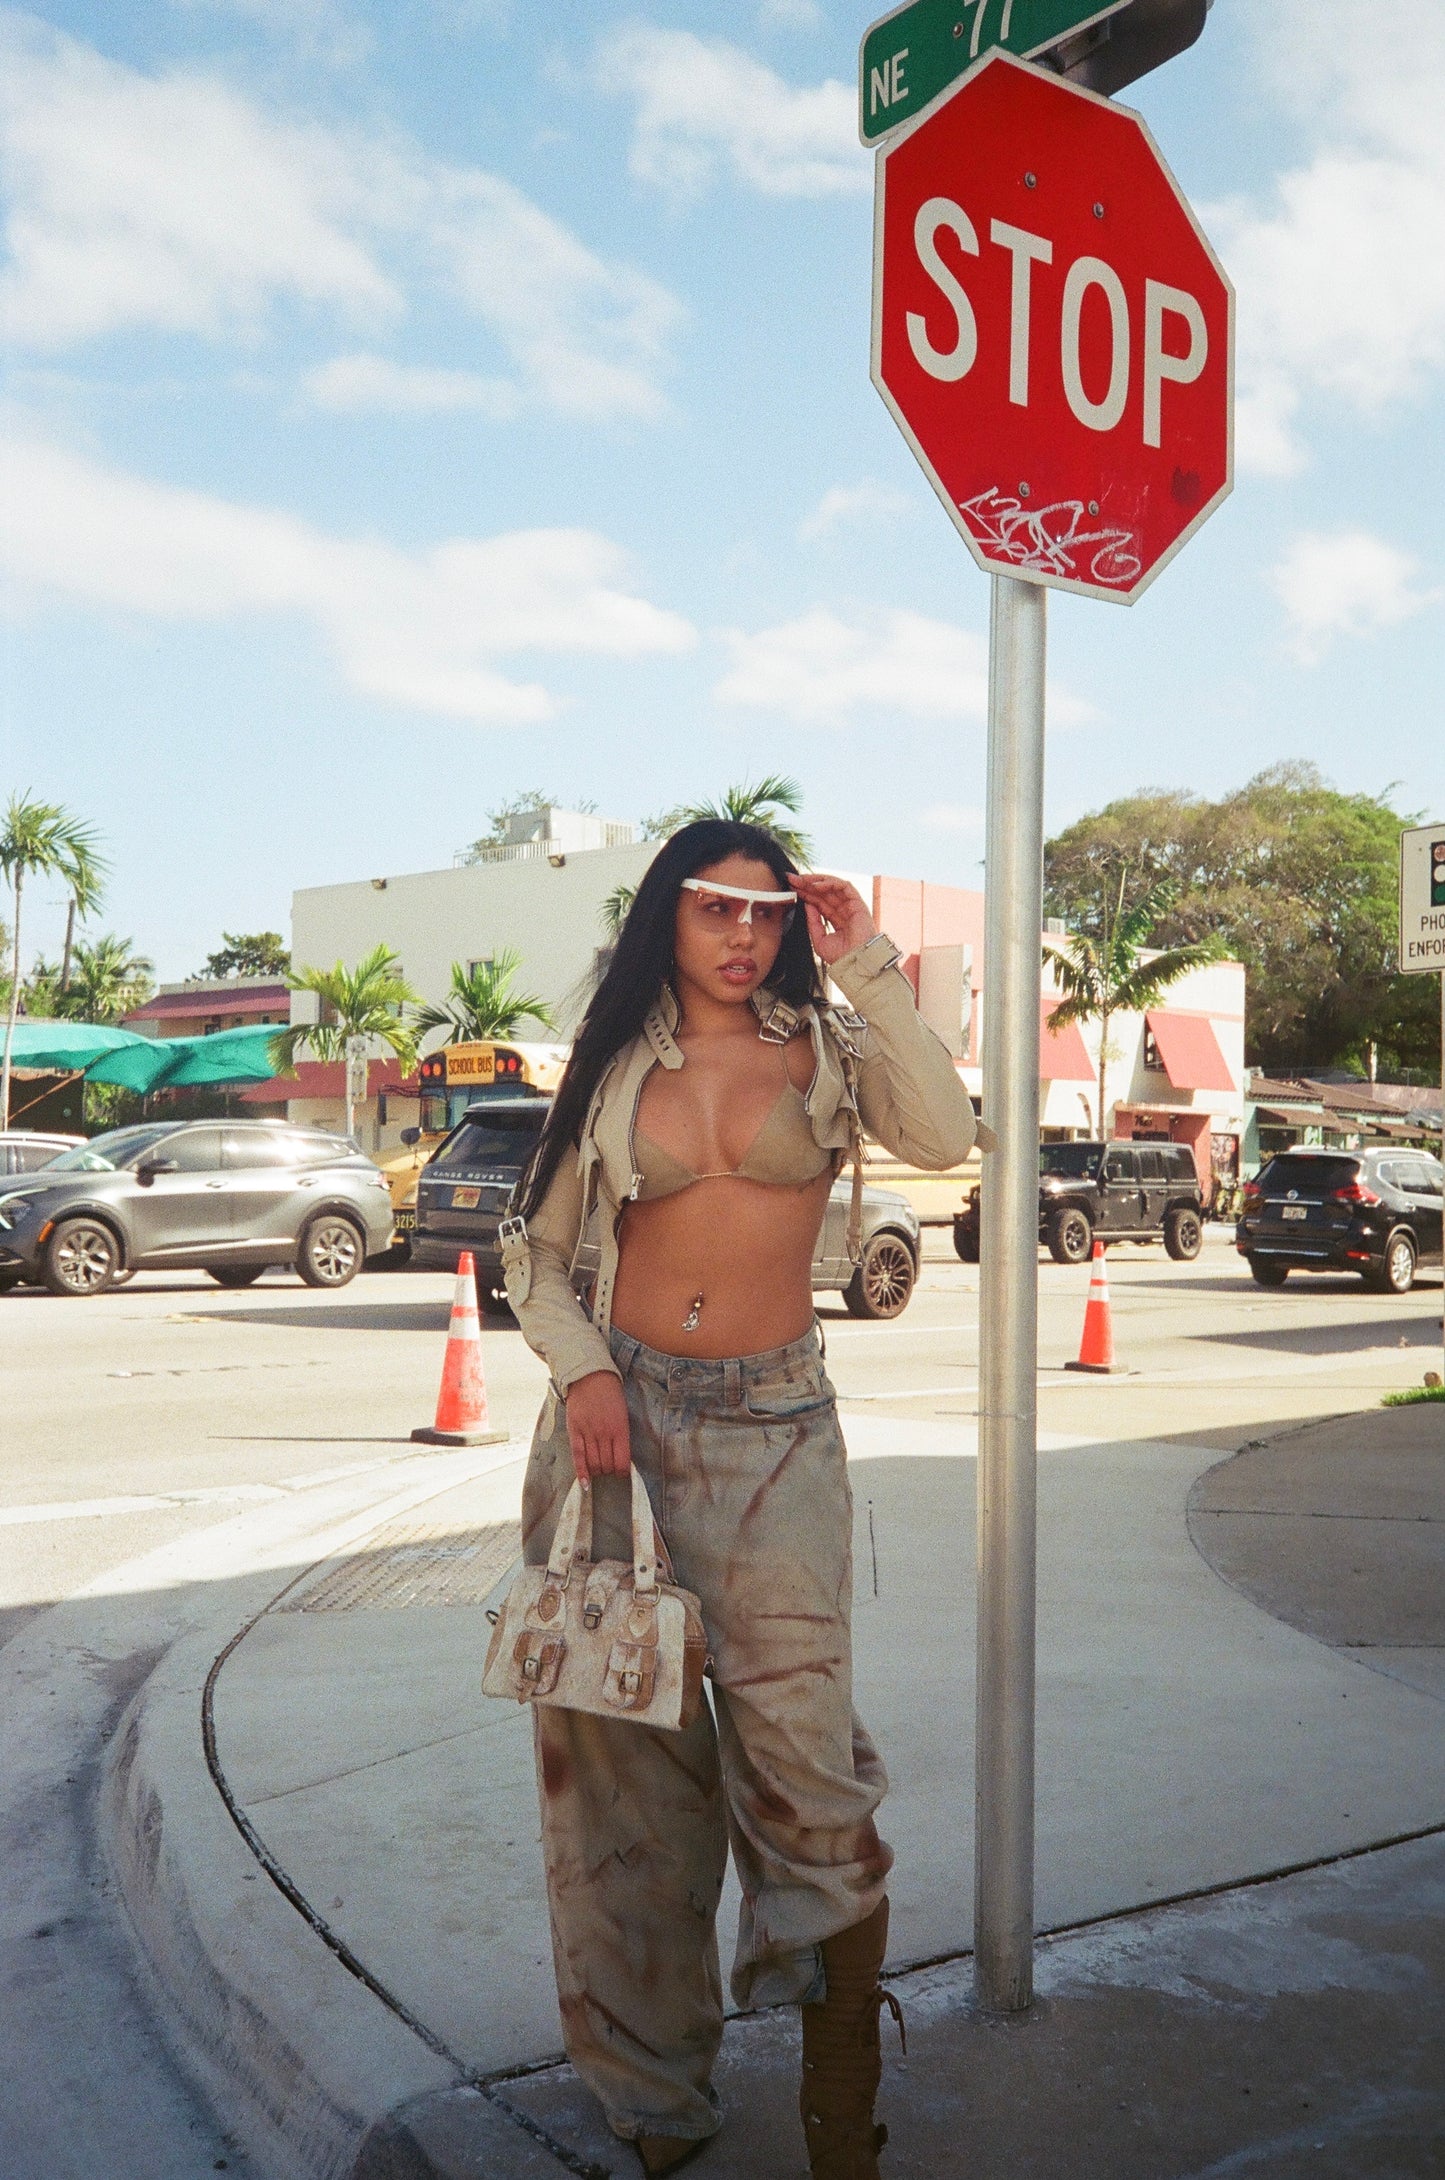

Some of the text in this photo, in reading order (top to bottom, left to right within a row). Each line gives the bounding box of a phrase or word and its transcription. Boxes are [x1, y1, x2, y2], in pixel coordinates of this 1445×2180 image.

[870, 48, 909, 116] NE
[906, 197, 1208, 449] STOP
[448, 1055, 493, 1075] SCHOOL BUS
[395, 1214, 417, 1229] 3215
